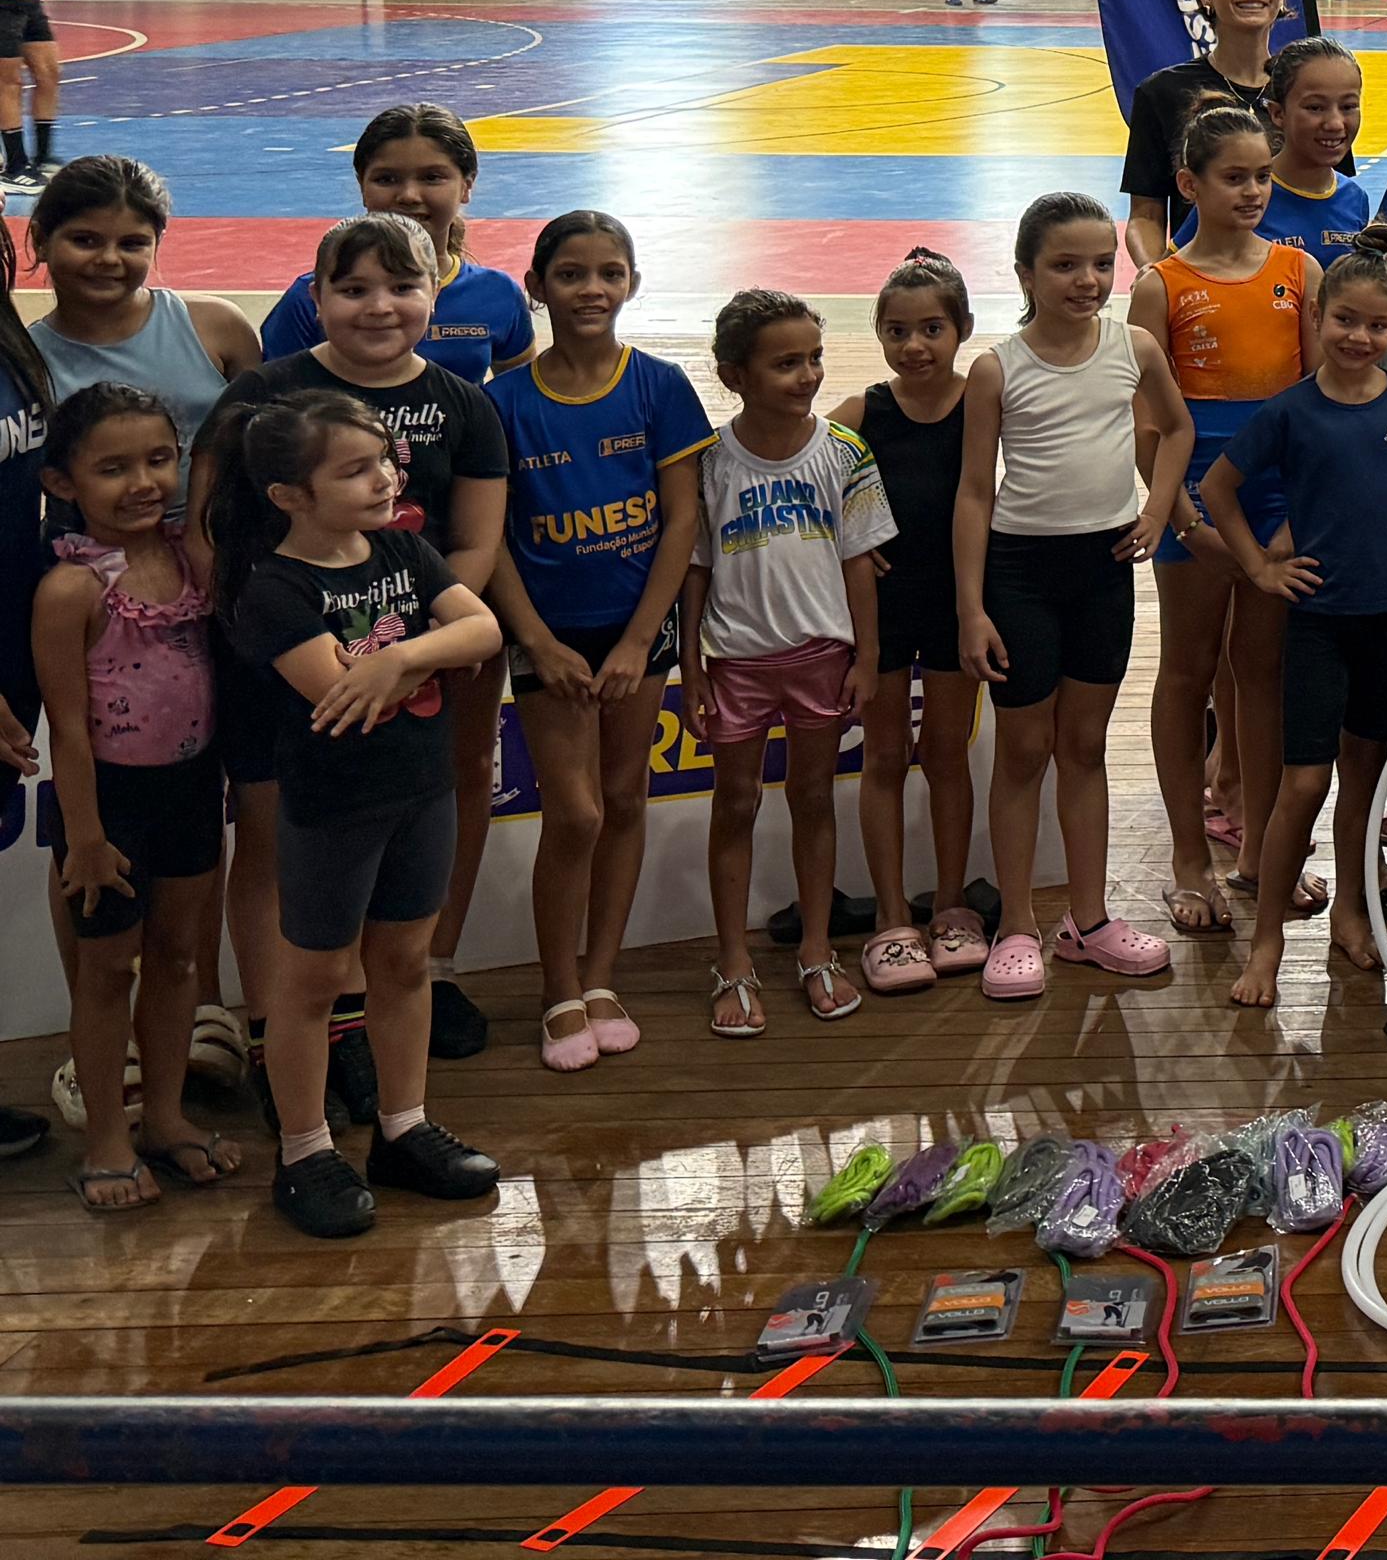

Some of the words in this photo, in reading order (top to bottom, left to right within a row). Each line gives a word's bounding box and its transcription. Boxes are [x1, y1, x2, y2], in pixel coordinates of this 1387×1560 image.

[441, 326, 487, 336] PREFCG
[518, 451, 572, 470] ATLETA
[739, 483, 766, 514] EU
[532, 490, 657, 546] FUNESP
[576, 535, 627, 555] Fundação
[620, 546, 632, 559] de
[1204, 1295, 1249, 1306] VOLLO
[938, 1308, 985, 1318] VOLLO
